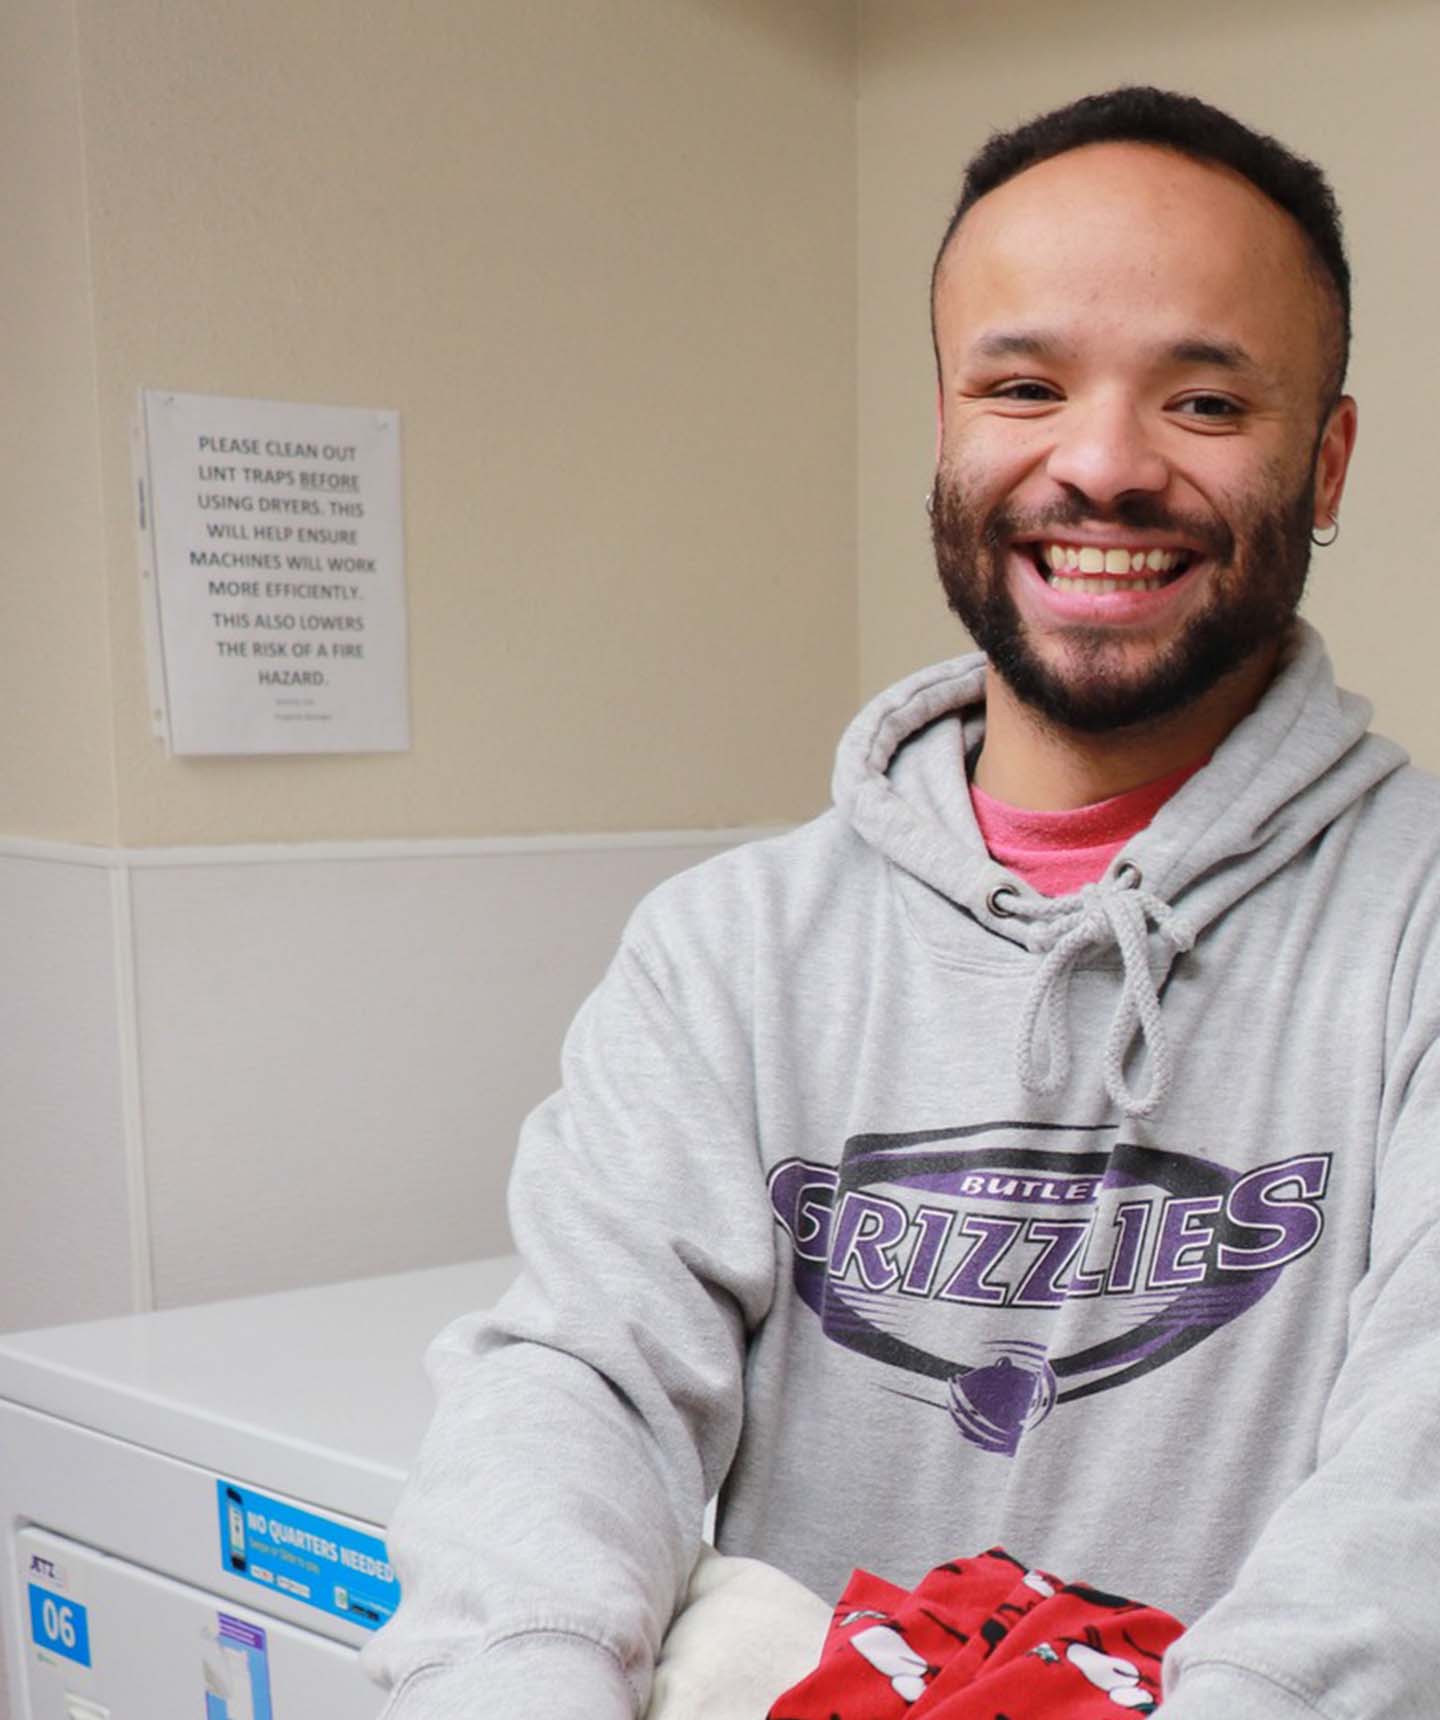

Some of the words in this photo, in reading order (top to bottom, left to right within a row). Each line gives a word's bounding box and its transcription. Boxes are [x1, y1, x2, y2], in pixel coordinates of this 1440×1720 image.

[199, 436, 260, 455] PLEASE
[266, 440, 318, 459] CLEAN
[322, 445, 357, 462] OUT
[198, 466, 236, 483] LINT
[242, 468, 295, 486] TRAPS
[300, 472, 360, 490] BEFORE
[197, 495, 254, 512] USING
[258, 498, 325, 516] DRYERS.
[329, 502, 365, 518] THIS
[206, 523, 249, 541] WILL
[254, 525, 294, 543] HELP
[297, 528, 358, 545] ENSURE
[189, 552, 282, 570] MACHINES
[285, 555, 324, 572] WILL
[327, 557, 377, 574] WORK
[208, 580, 260, 598] MORE
[265, 582, 363, 601] EFFICIENTLY.
[212, 613, 251, 630] THIS
[254, 613, 295, 631] ALSO
[299, 615, 365, 632] LOWERS
[216, 641, 248, 658] THE
[252, 642, 288, 659] RISK
[291, 643, 312, 660] OF
[316, 643, 329, 659] A
[332, 643, 365, 660] FIRE
[247, 1511, 267, 1534] NO
[269, 1519, 339, 1563] QUARTERS
[339, 1546, 395, 1583] NEEDED
[43, 1598, 77, 1649] 06
